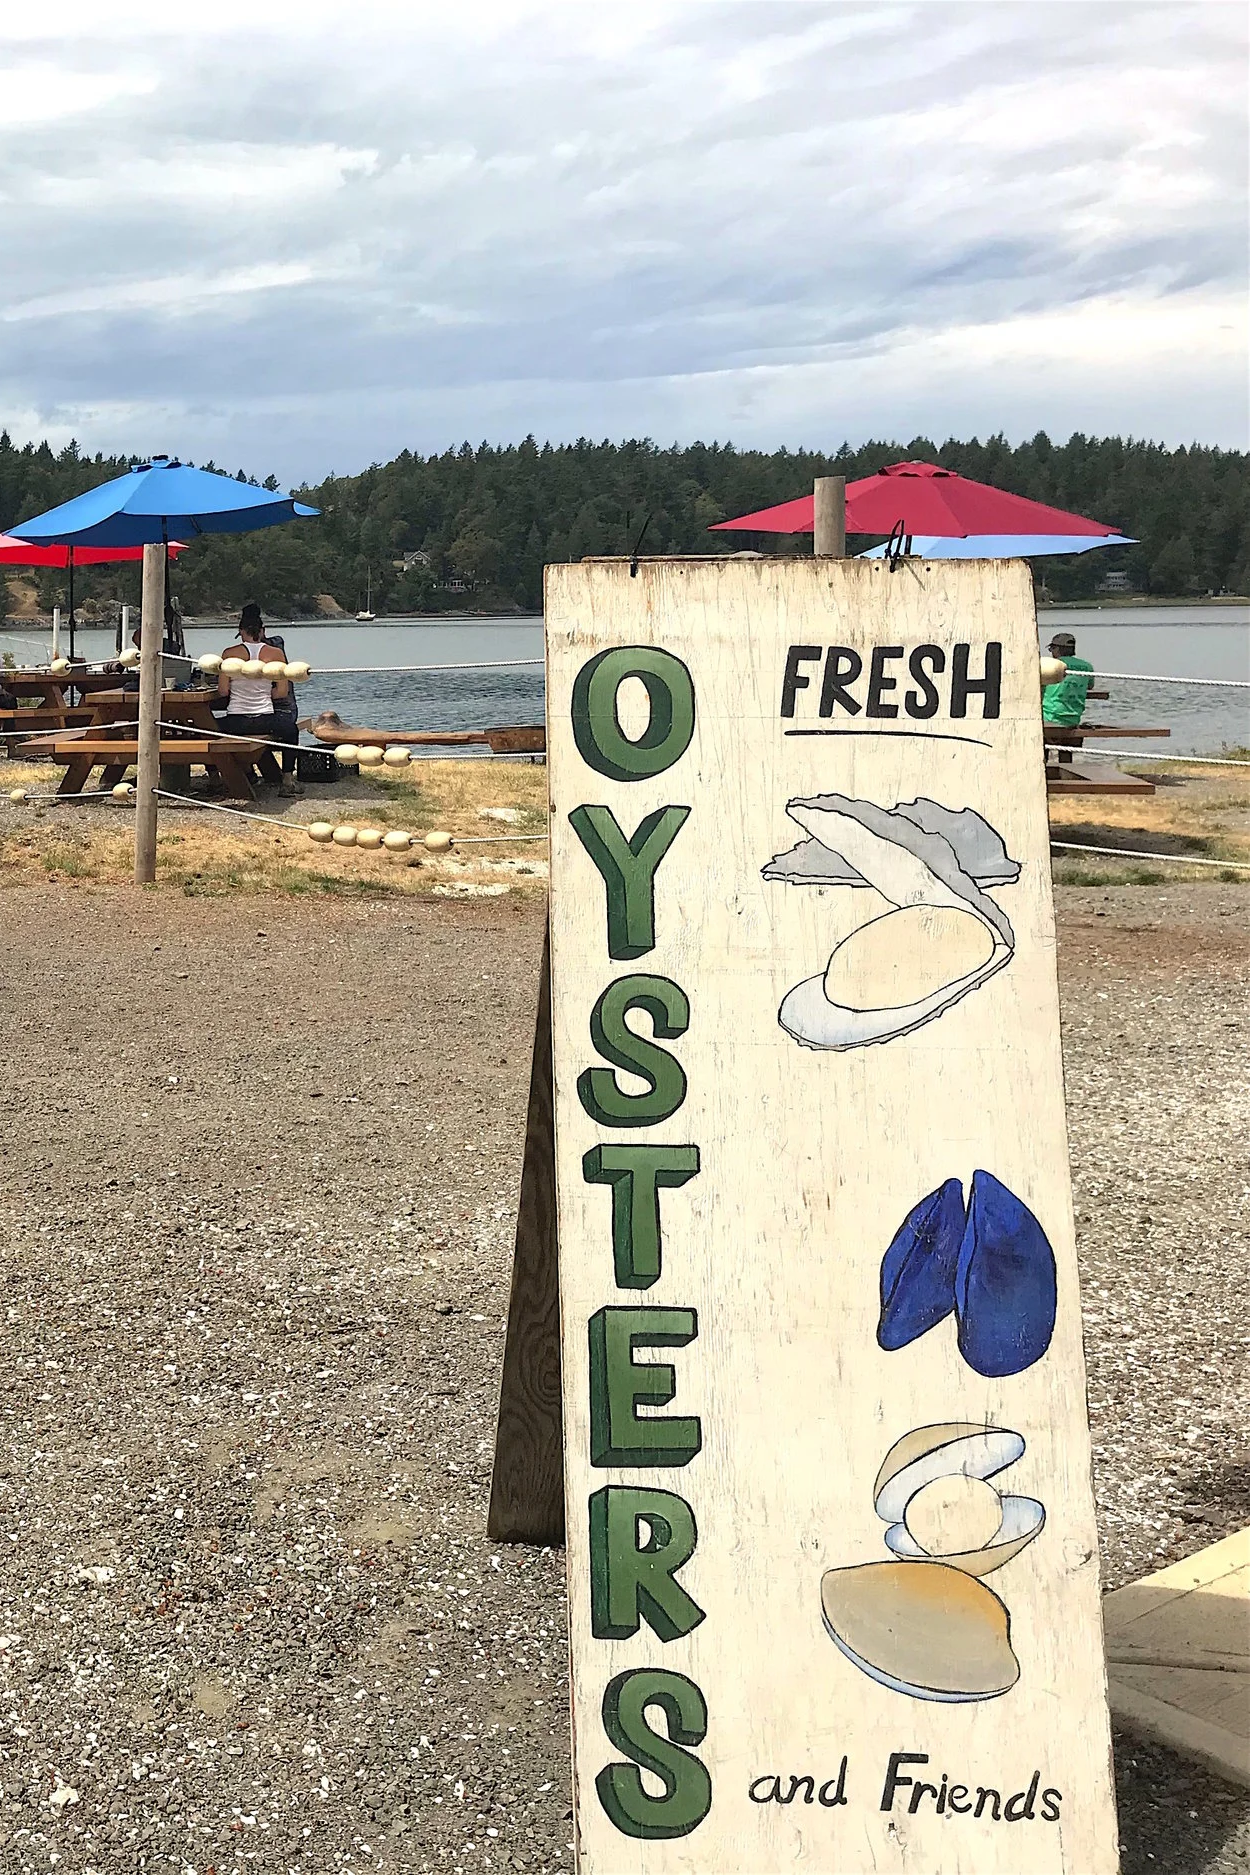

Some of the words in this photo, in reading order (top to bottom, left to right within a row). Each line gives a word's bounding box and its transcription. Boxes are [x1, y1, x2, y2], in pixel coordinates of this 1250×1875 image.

[780, 641, 1002, 720] FRESH
[568, 645, 713, 1840] OYSTERS
[748, 1755, 848, 1807] and
[879, 1752, 1063, 1822] Friends
